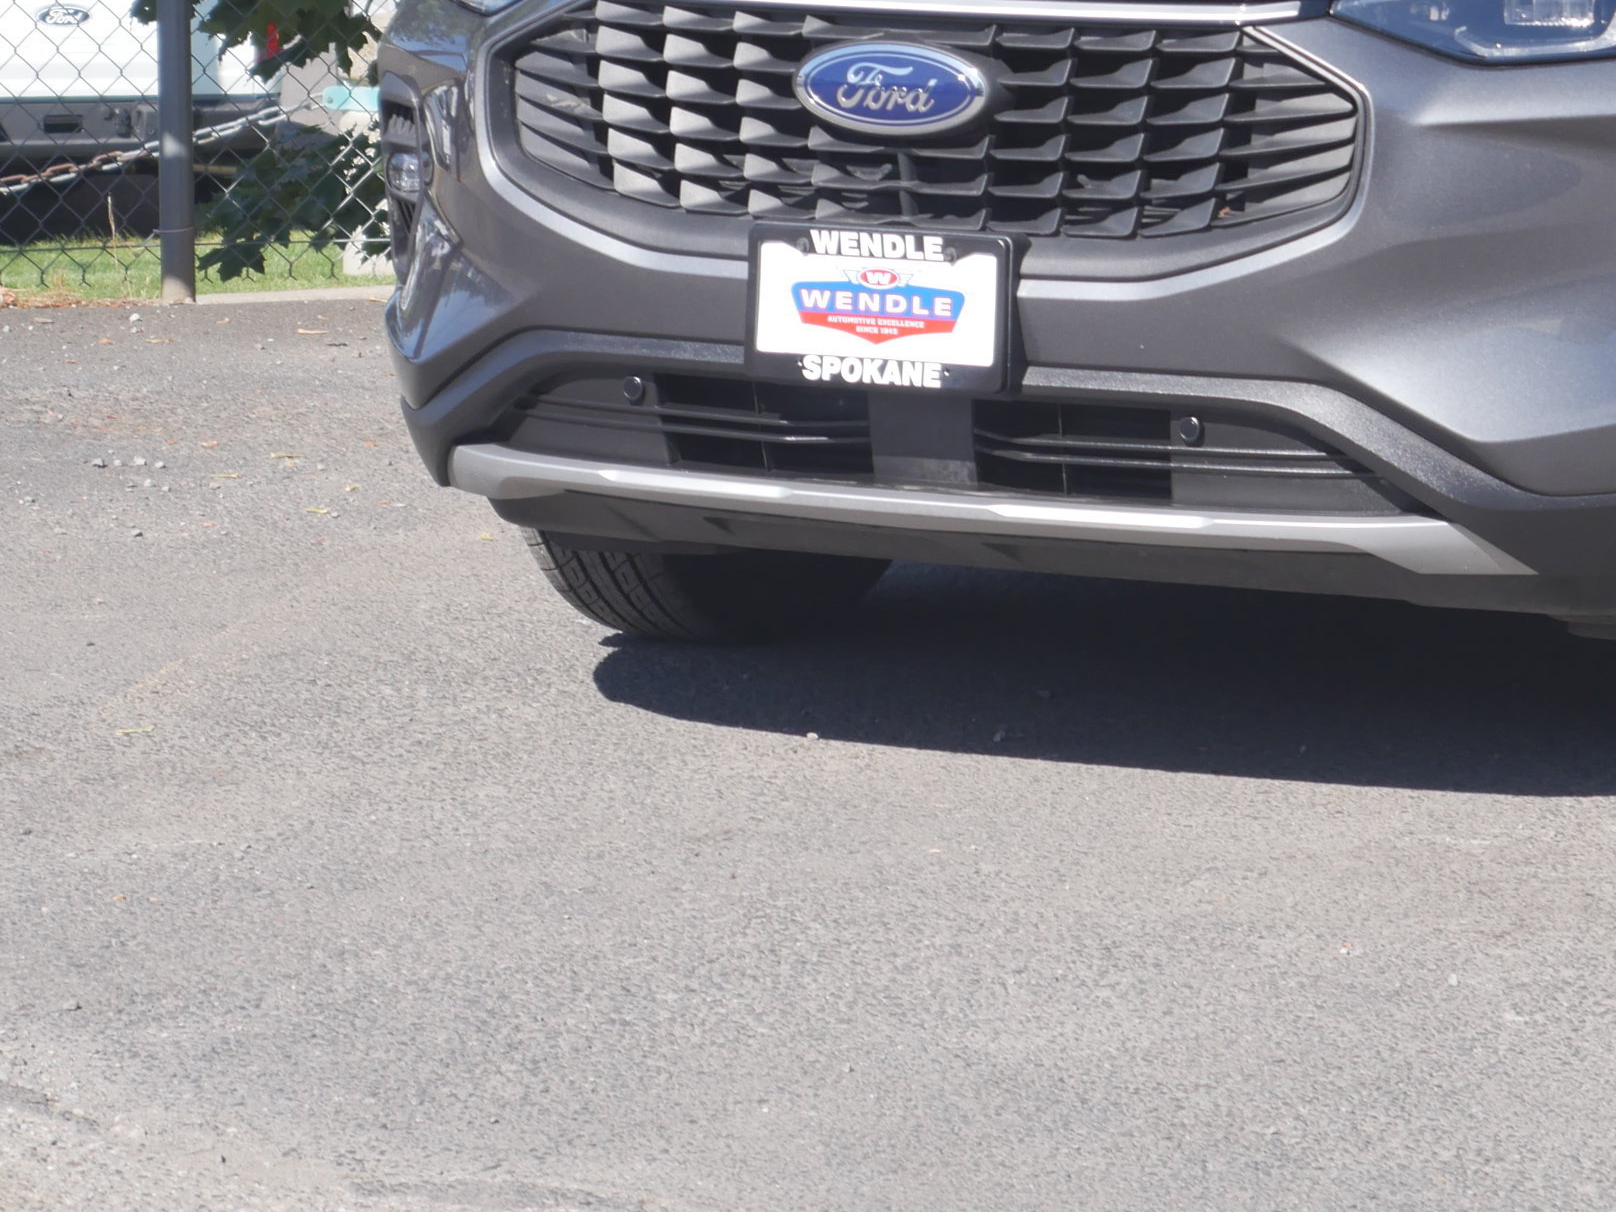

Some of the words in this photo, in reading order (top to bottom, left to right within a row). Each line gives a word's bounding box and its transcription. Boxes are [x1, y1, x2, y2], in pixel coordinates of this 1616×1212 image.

[44, 9, 84, 25] Ford
[836, 61, 938, 113] Ford
[809, 229, 945, 262] WENDLE
[800, 289, 953, 317] WENDLE
[801, 354, 943, 389] SPOKANE
